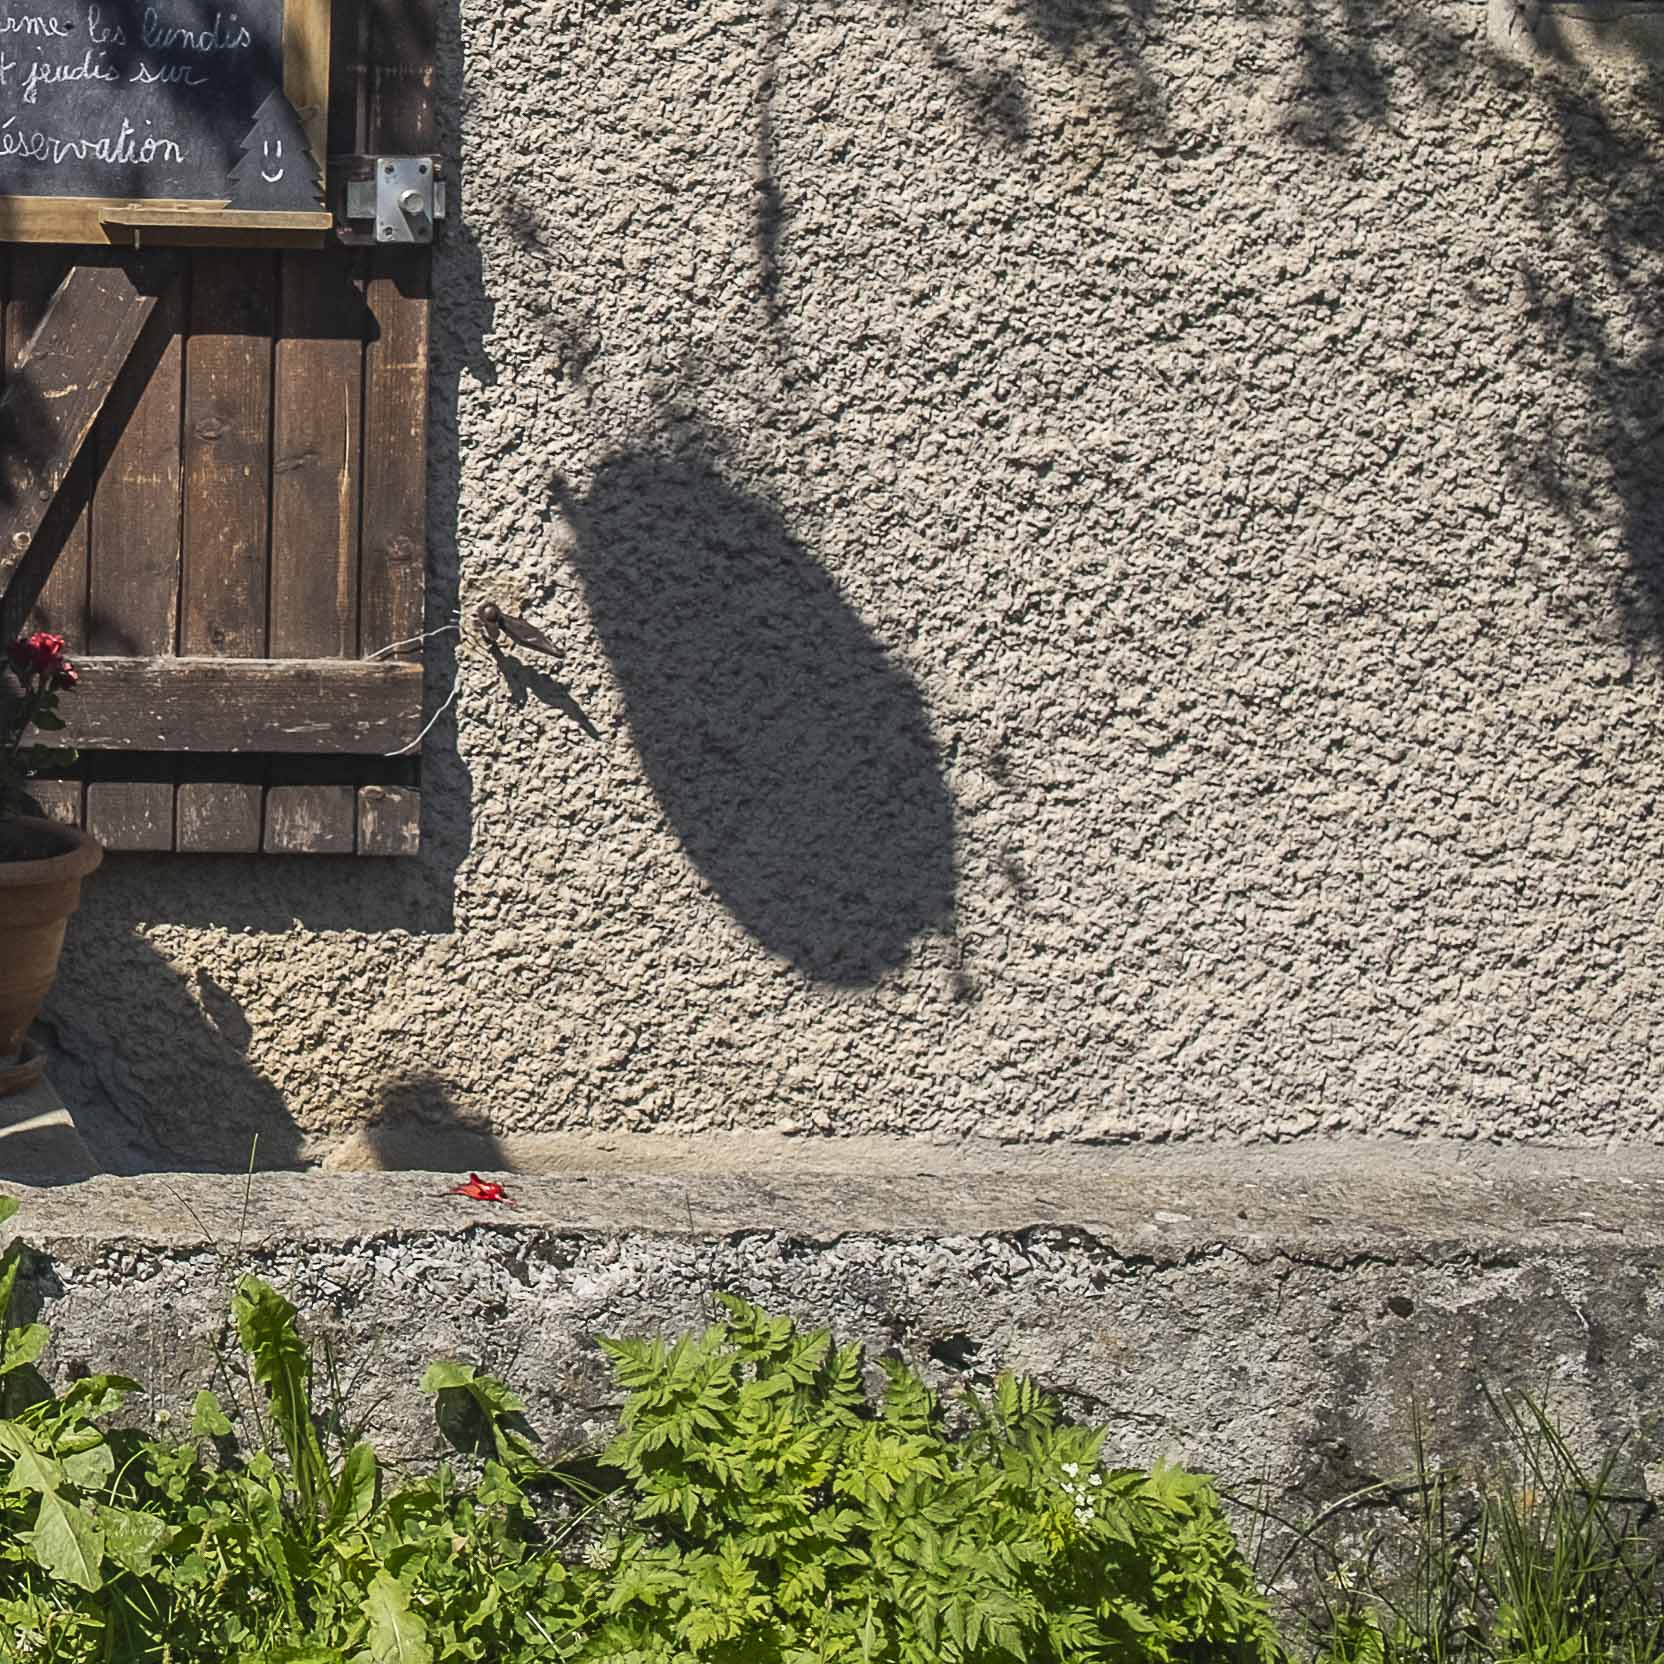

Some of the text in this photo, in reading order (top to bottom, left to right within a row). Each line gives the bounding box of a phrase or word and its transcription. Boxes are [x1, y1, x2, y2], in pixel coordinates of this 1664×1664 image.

[87, 4, 126, 46] les
[142, 7, 251, 51] lundis
[21, 46, 121, 104] jeudis
[129, 62, 208, 86] sur
